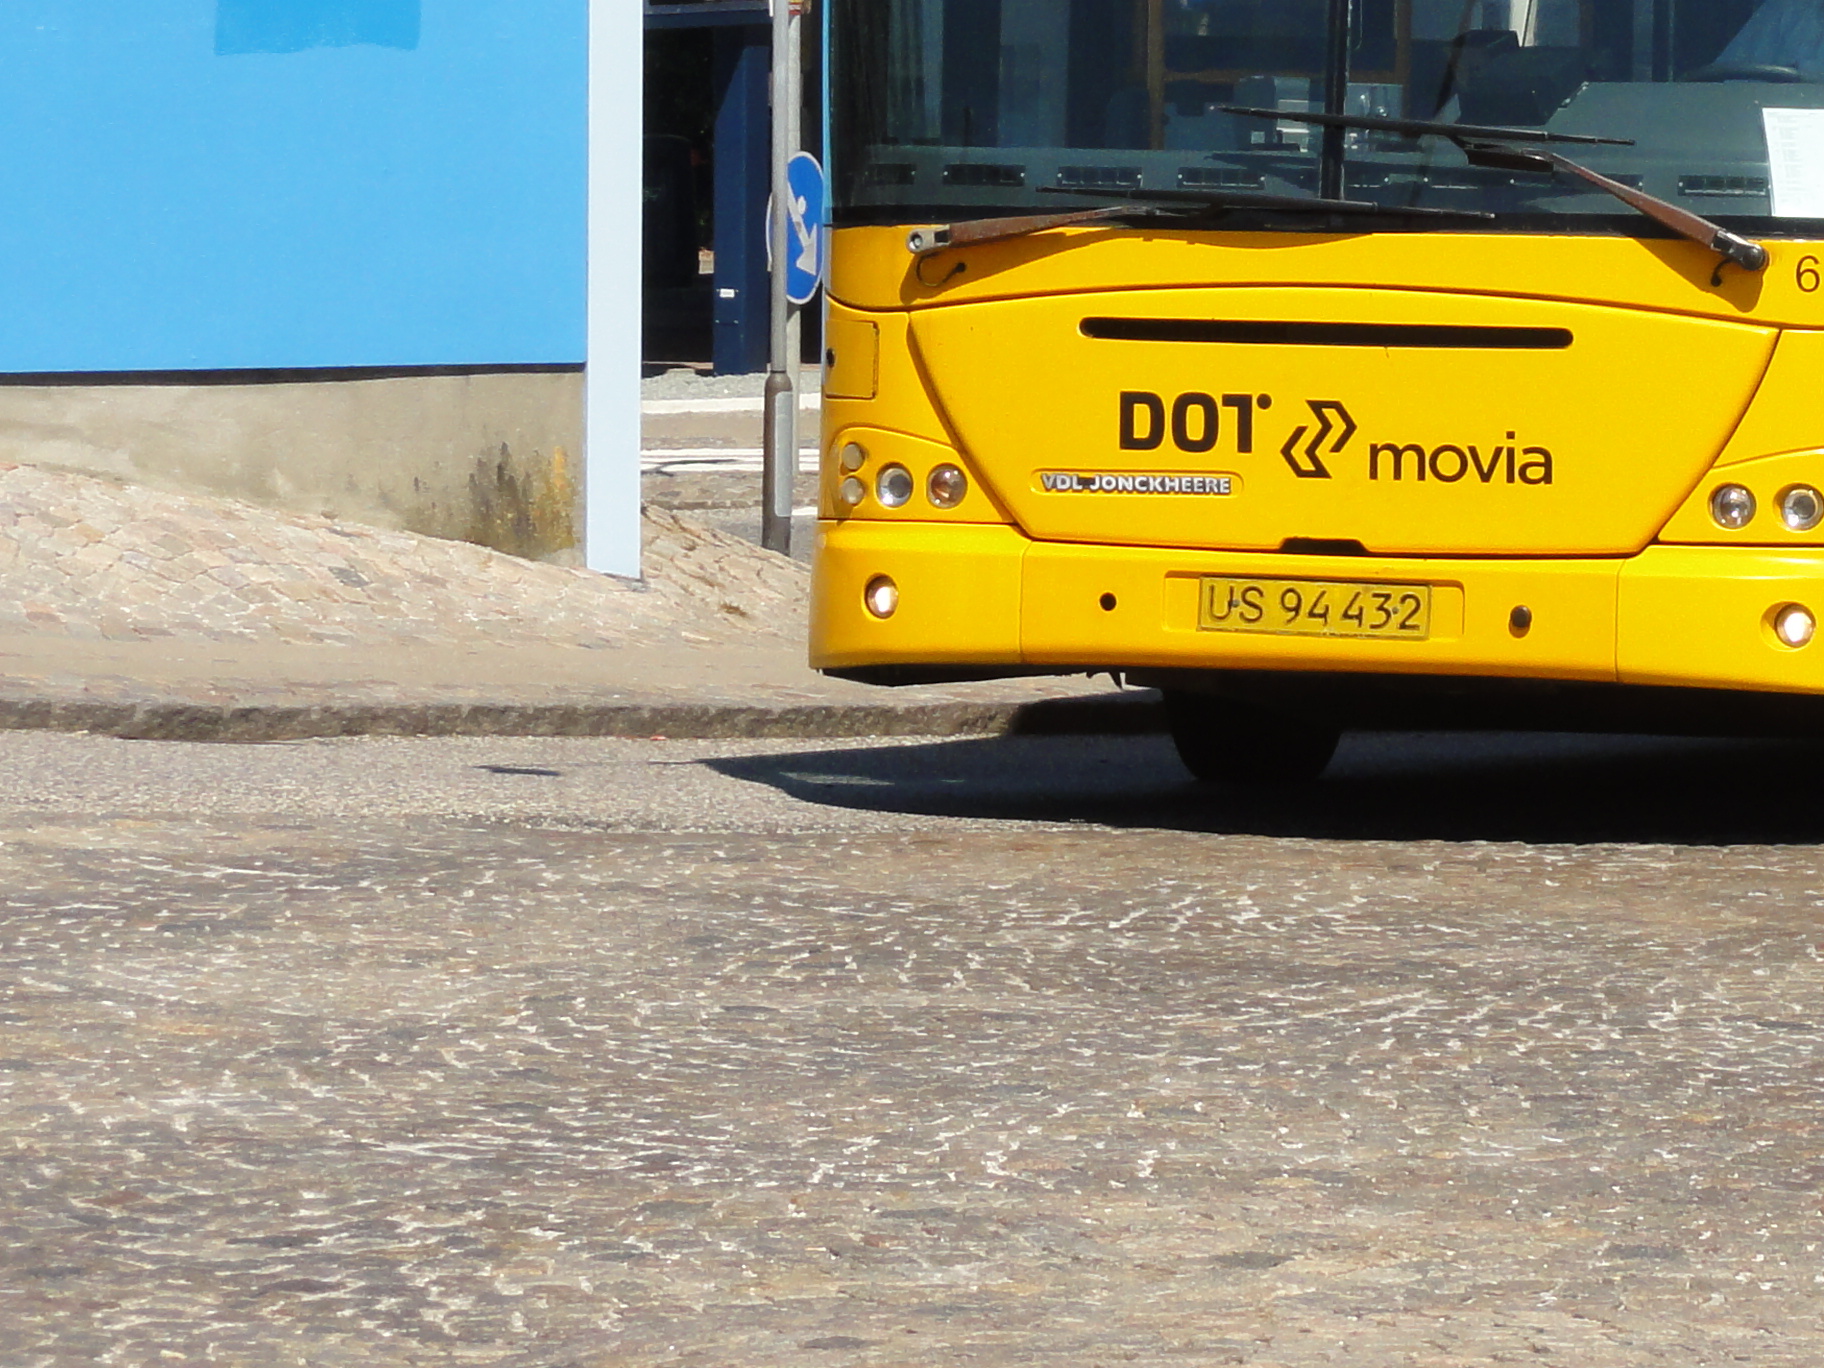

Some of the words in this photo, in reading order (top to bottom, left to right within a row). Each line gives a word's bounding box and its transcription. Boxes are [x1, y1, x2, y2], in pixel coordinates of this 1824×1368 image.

[1119, 390, 1254, 454] DOT
[1041, 473, 1083, 492] VDL
[1089, 474, 1231, 495] JONCKHEERE
[1369, 431, 1553, 486] movia
